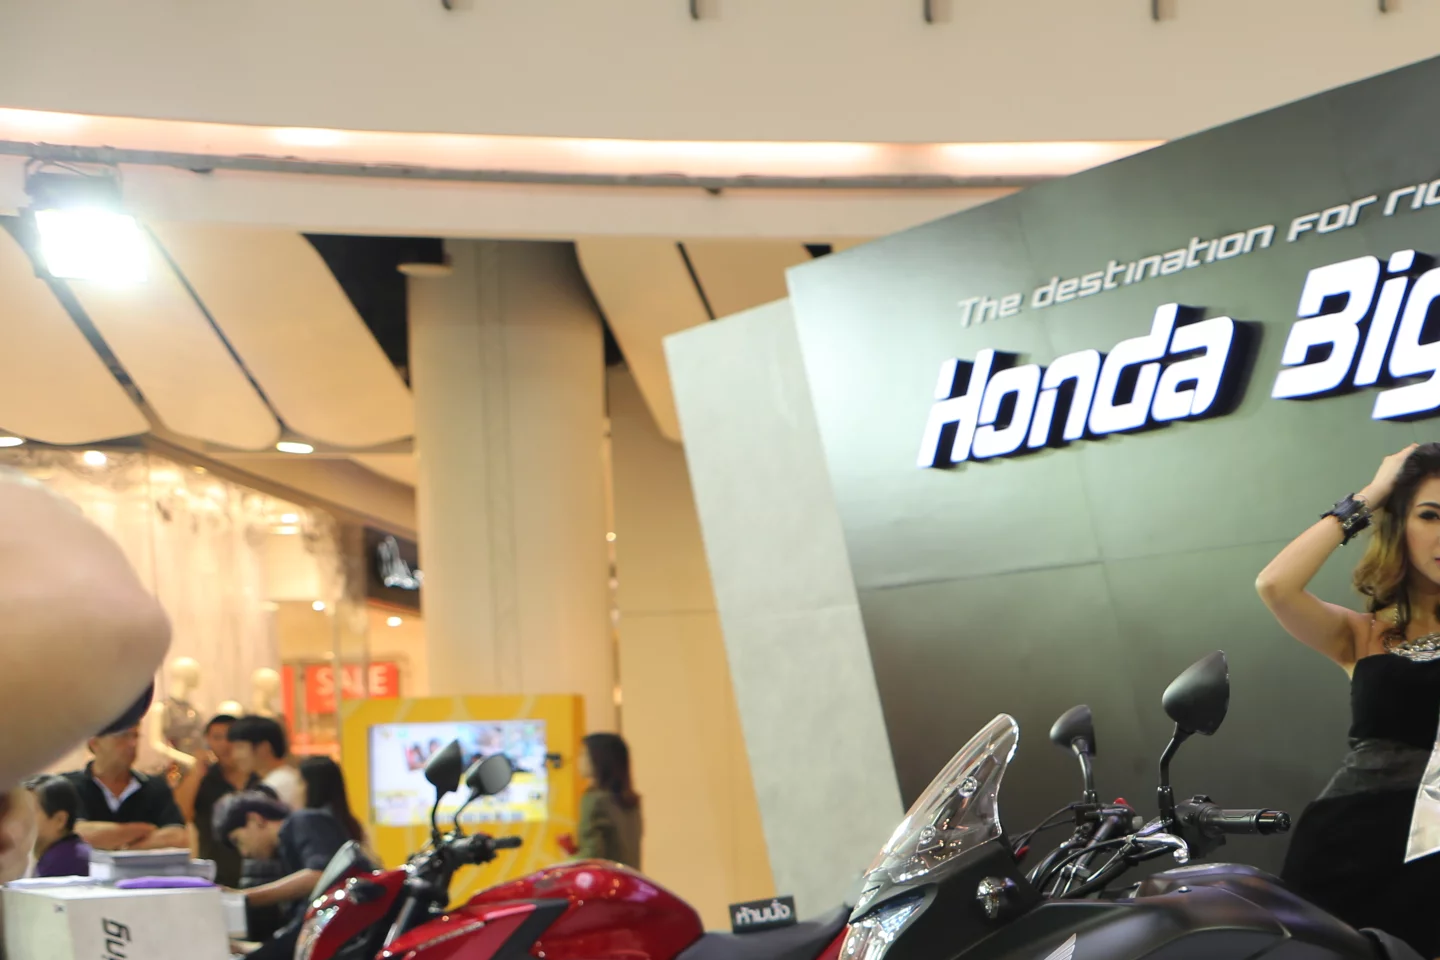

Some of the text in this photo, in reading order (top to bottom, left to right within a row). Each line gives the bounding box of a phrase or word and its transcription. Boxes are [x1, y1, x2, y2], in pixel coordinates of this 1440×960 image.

[957, 294, 1021, 328] The
[1031, 222, 1276, 310] destination
[916, 302, 1236, 469] Honda
